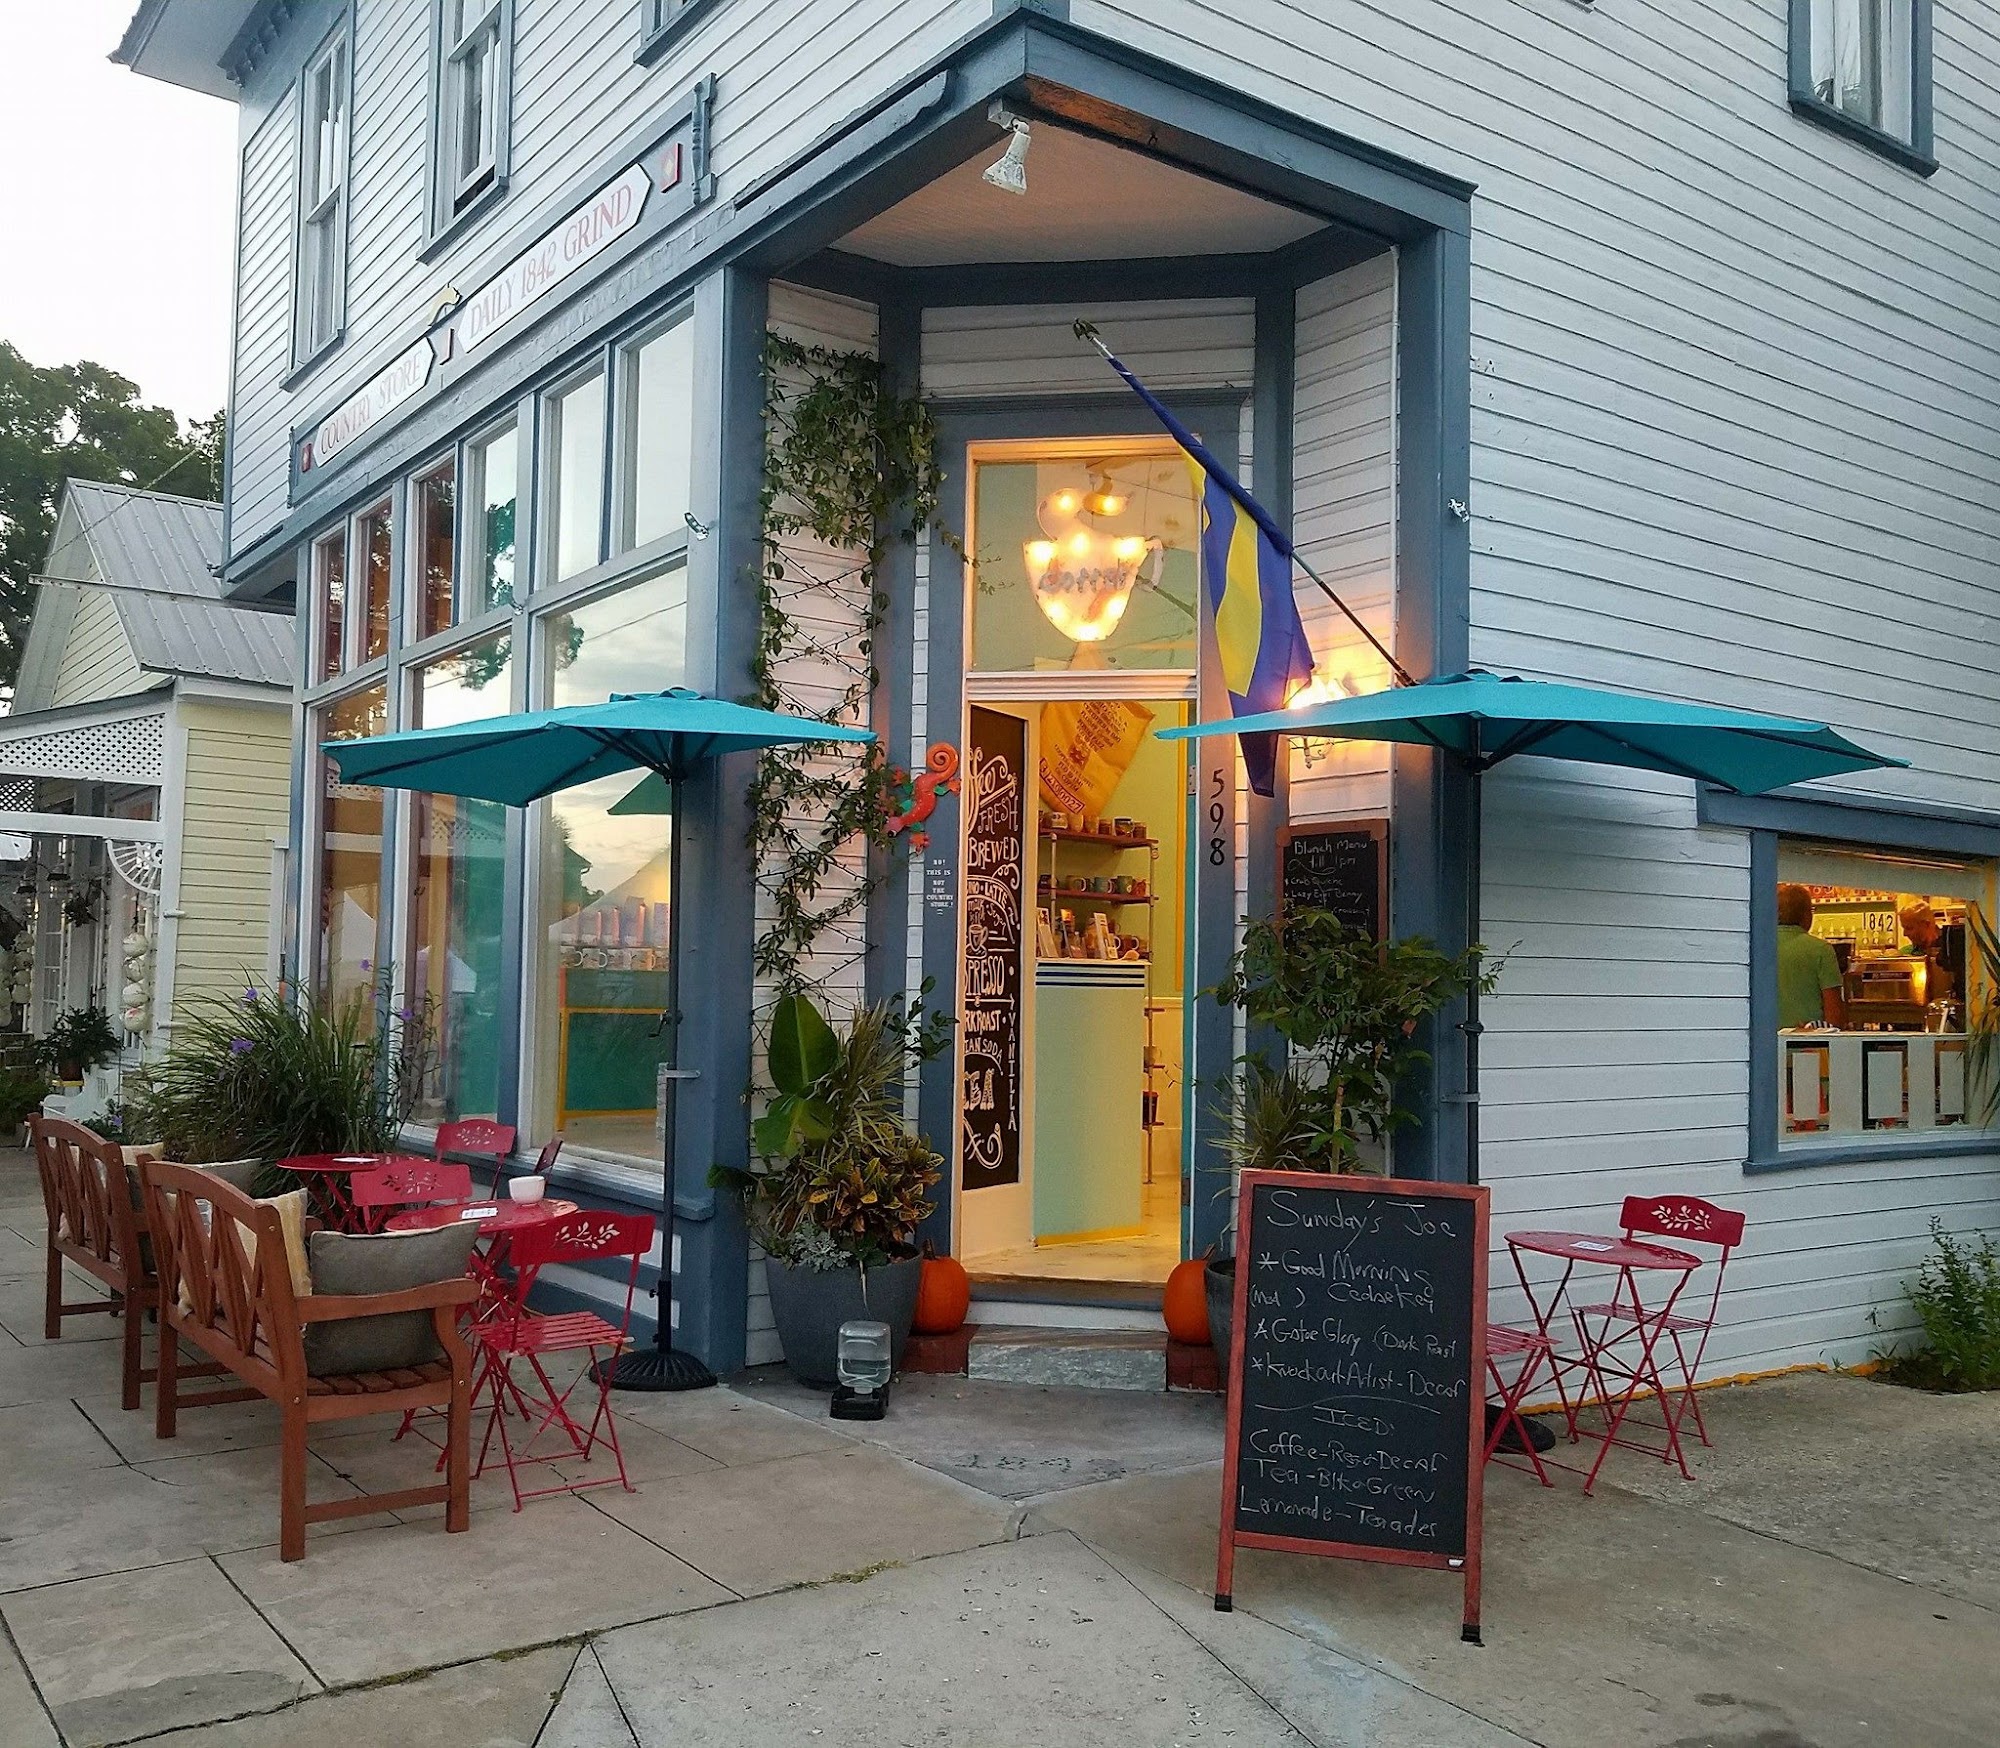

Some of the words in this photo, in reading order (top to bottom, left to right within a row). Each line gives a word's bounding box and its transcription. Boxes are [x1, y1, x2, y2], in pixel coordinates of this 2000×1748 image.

[470, 274, 516, 339] DAILY
[521, 241, 557, 299] 1842
[563, 183, 633, 262] GRIND
[379, 350, 422, 409] STORE
[978, 795, 1018, 834] FRESH
[1210, 769, 1225, 865] 598
[968, 837, 1019, 868] BREWED
[1337, 840, 1367, 850] Menu
[984, 881, 1008, 909] LATTE
[1863, 912, 1894, 932] 1842
[982, 1038, 1003, 1063] SODA
[1008, 1012, 1018, 1132] VANILLA
[1267, 1190, 1383, 1252] Sunday's
[1386, 1201, 1455, 1237] Joe
[1282, 1249, 1325, 1278] Good
